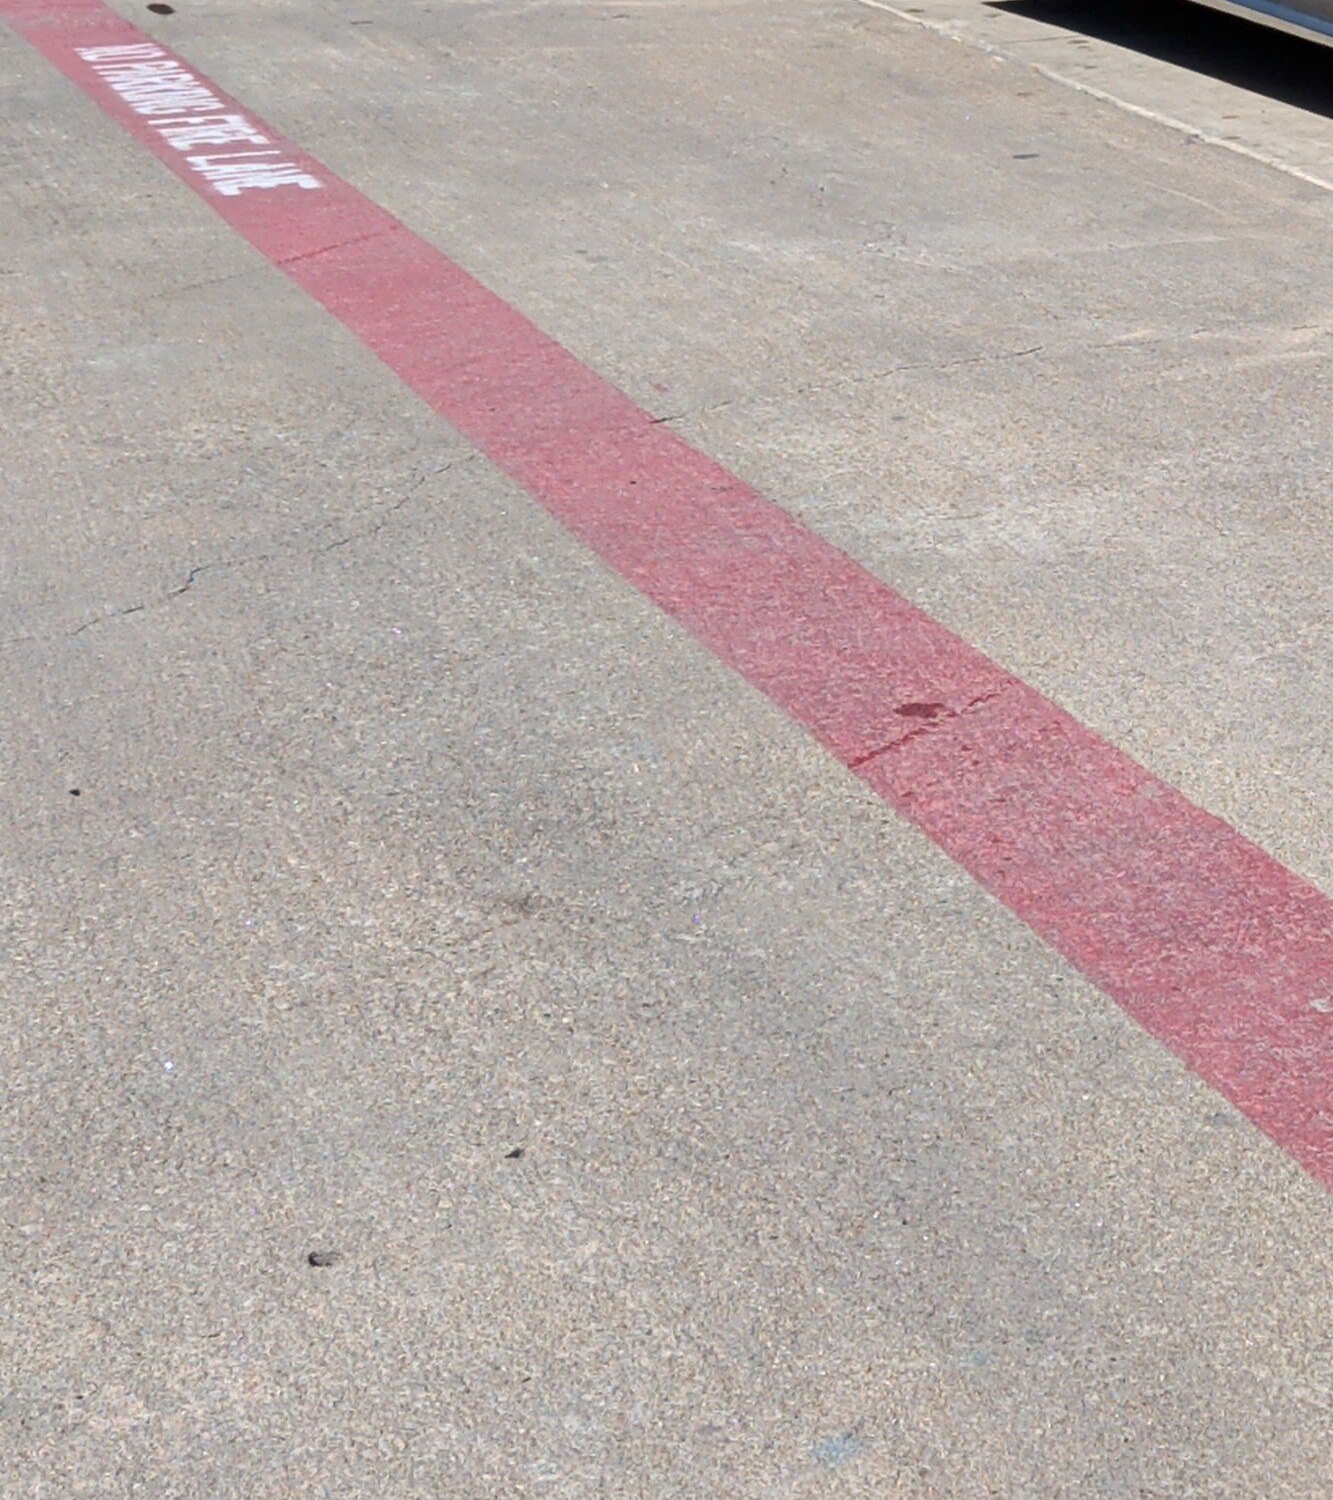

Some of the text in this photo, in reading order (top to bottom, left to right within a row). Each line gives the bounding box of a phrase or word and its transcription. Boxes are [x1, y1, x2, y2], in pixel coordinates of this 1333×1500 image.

[74, 43, 324, 196] NO PARKING FIRE LANE
